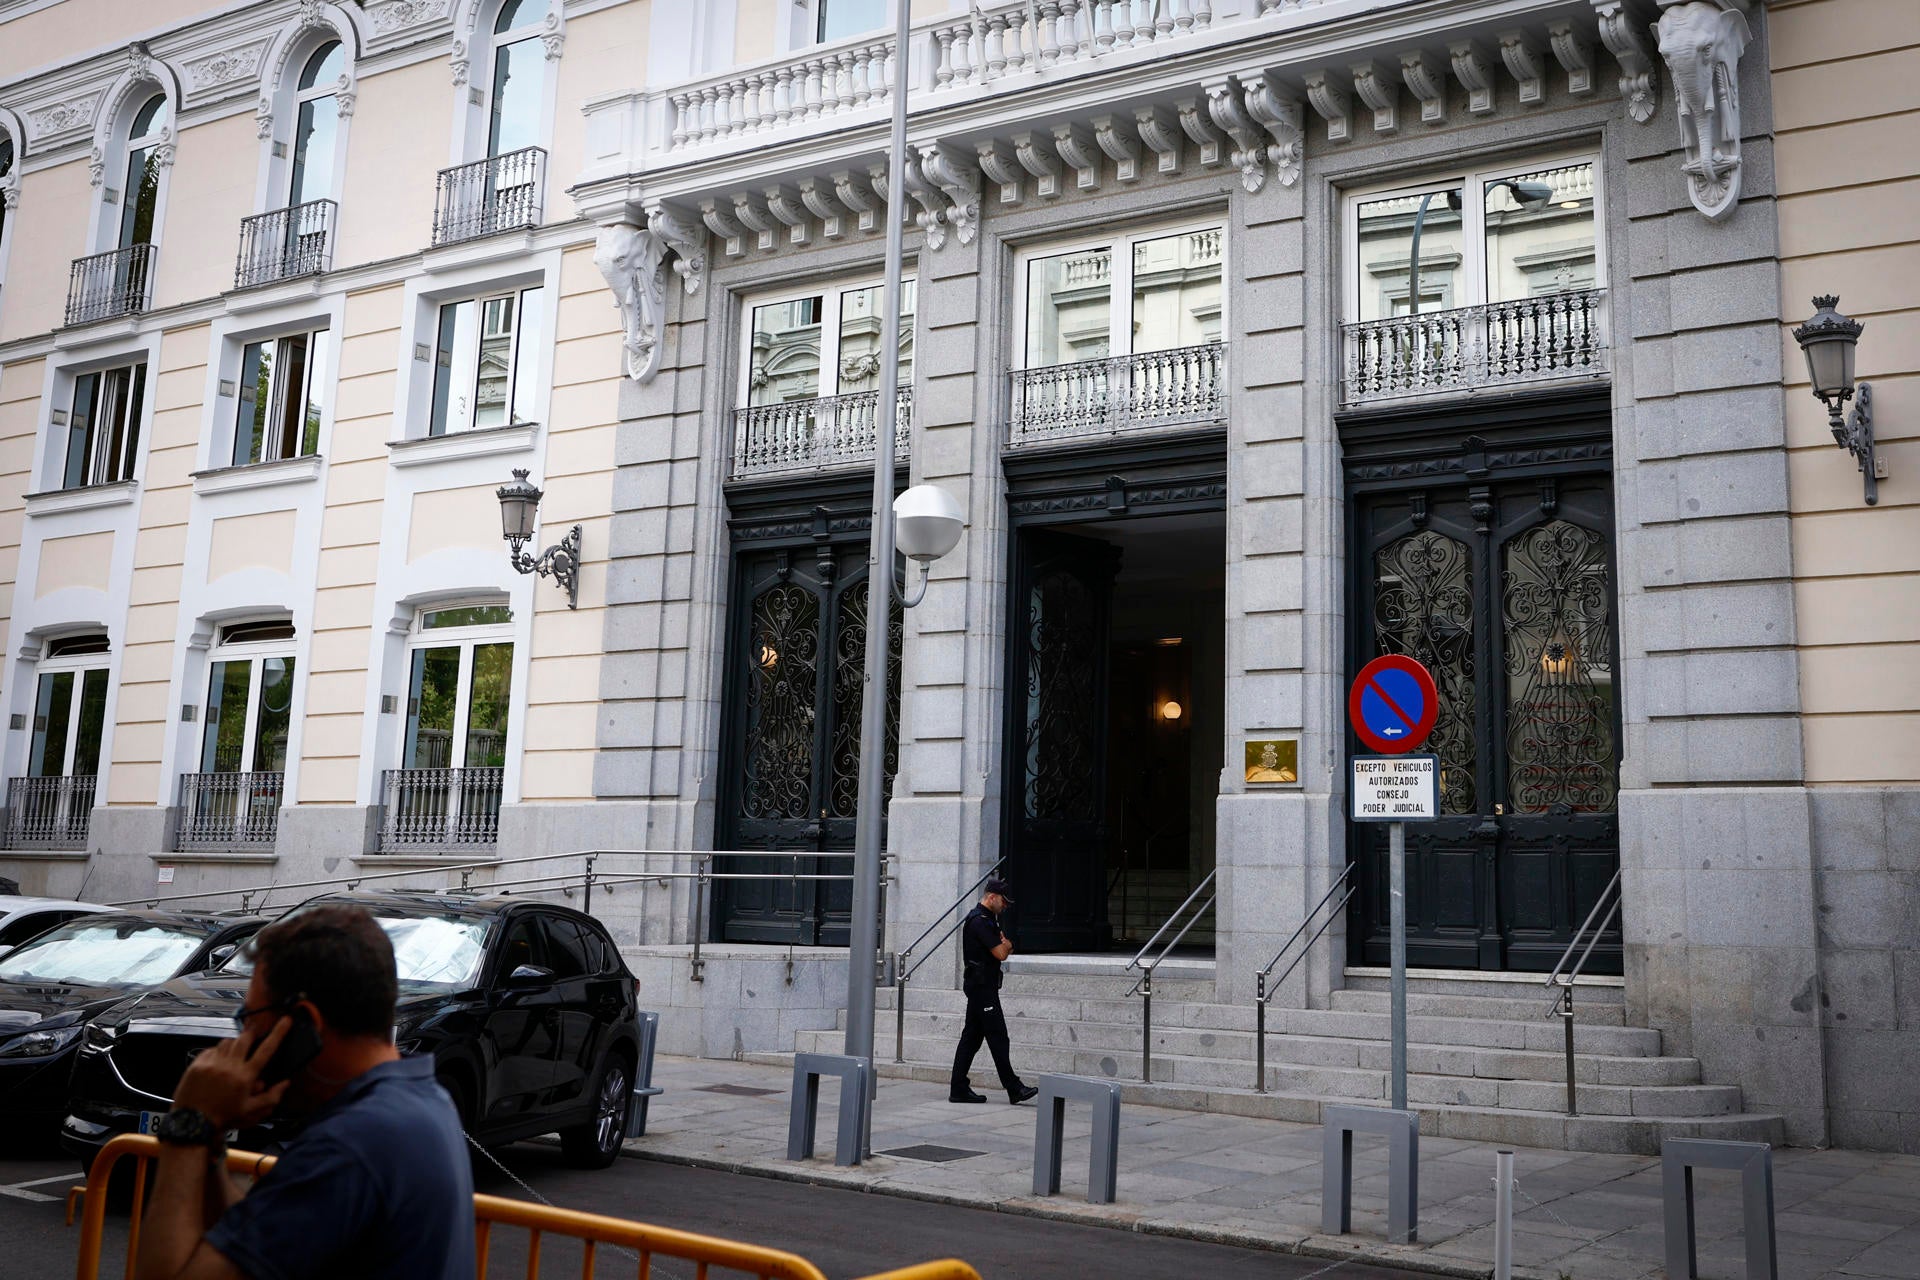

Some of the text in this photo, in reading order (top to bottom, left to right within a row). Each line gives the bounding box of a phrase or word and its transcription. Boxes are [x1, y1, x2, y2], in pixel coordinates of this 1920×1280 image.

[1355, 762, 1432, 773] EXCEPTO VEHICULOS
[1368, 776, 1419, 786] AUTORIZADOS
[1376, 789, 1409, 800] CONSEJO
[1362, 803, 1425, 813] PODER JUDICIAL
